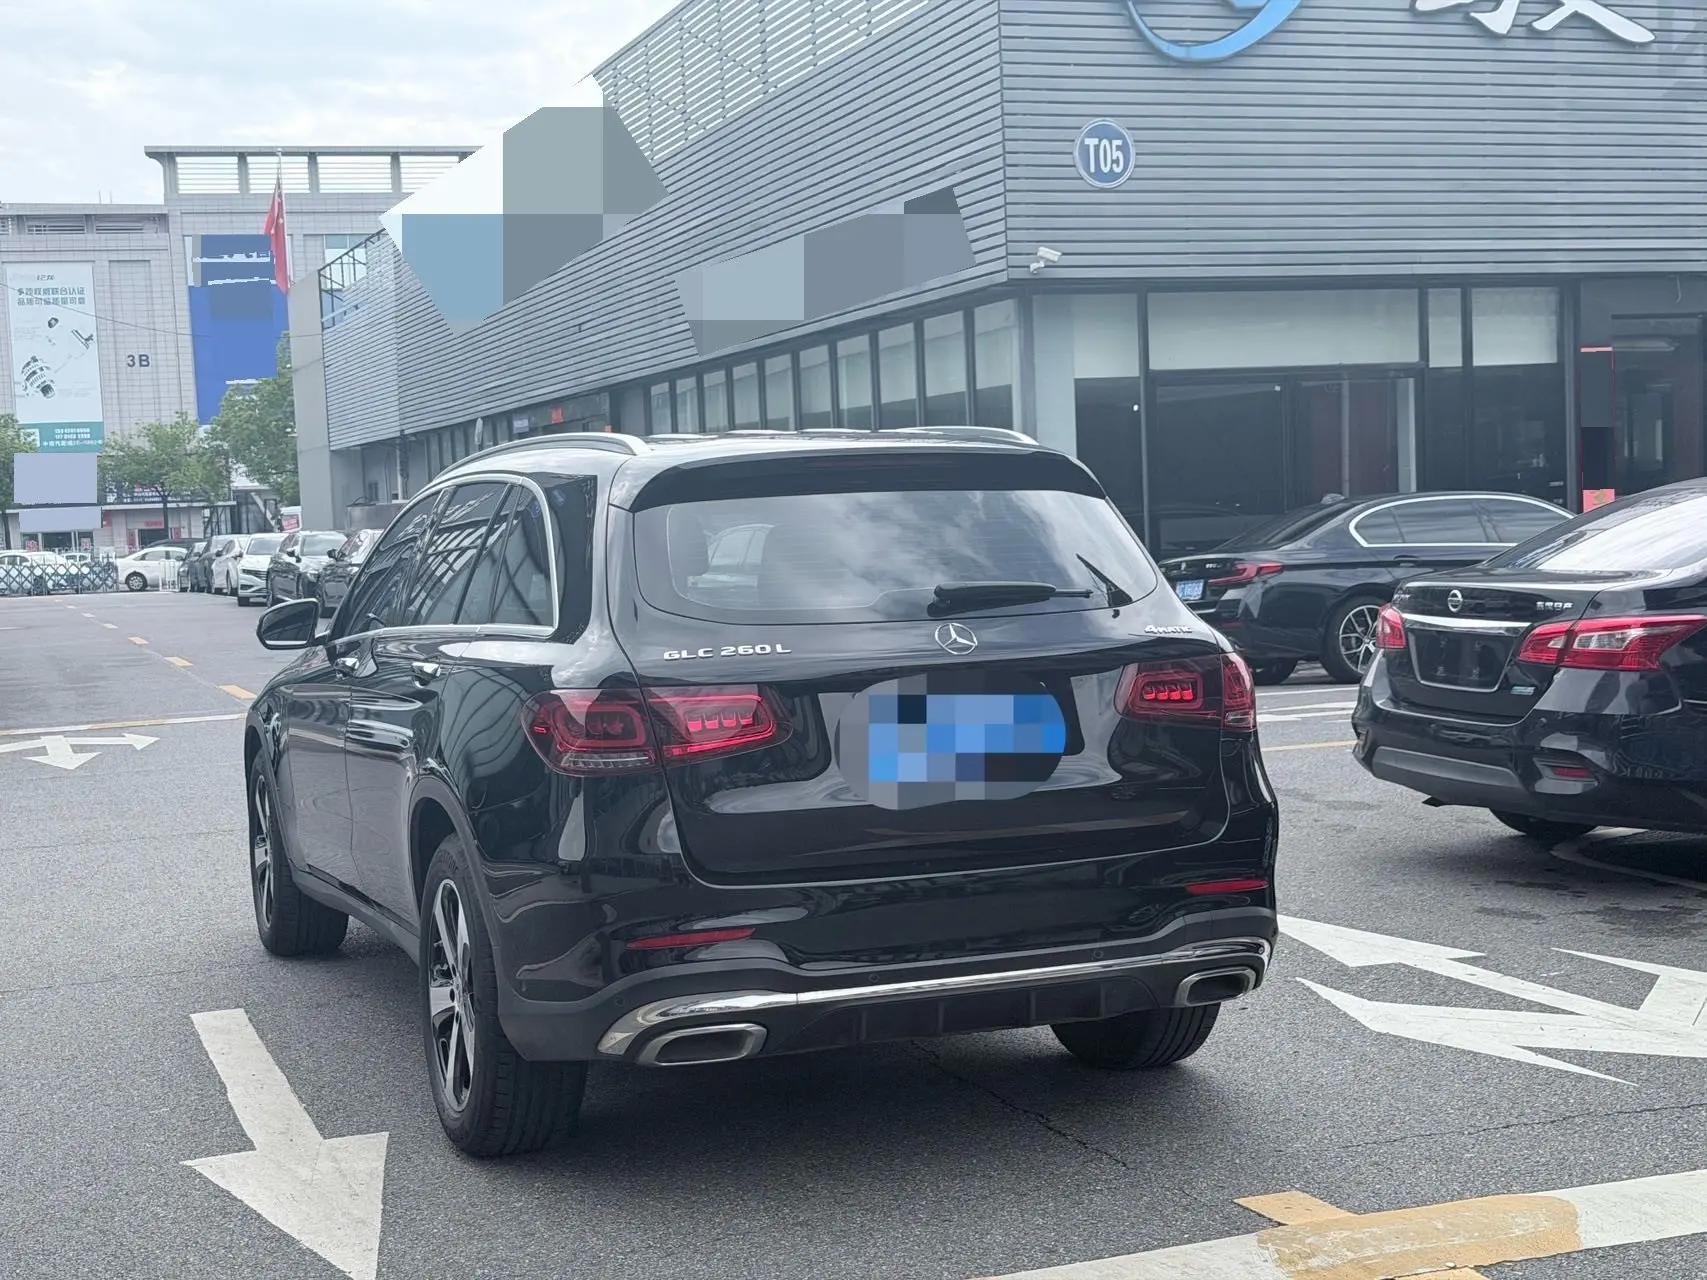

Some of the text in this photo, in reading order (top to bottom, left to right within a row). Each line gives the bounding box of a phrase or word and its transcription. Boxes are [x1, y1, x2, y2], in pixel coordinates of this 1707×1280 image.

[1084, 137, 1124, 173] T05
[127, 354, 150, 368] 3B
[663, 647, 715, 661] GLC
[720, 644, 771, 657] 260
